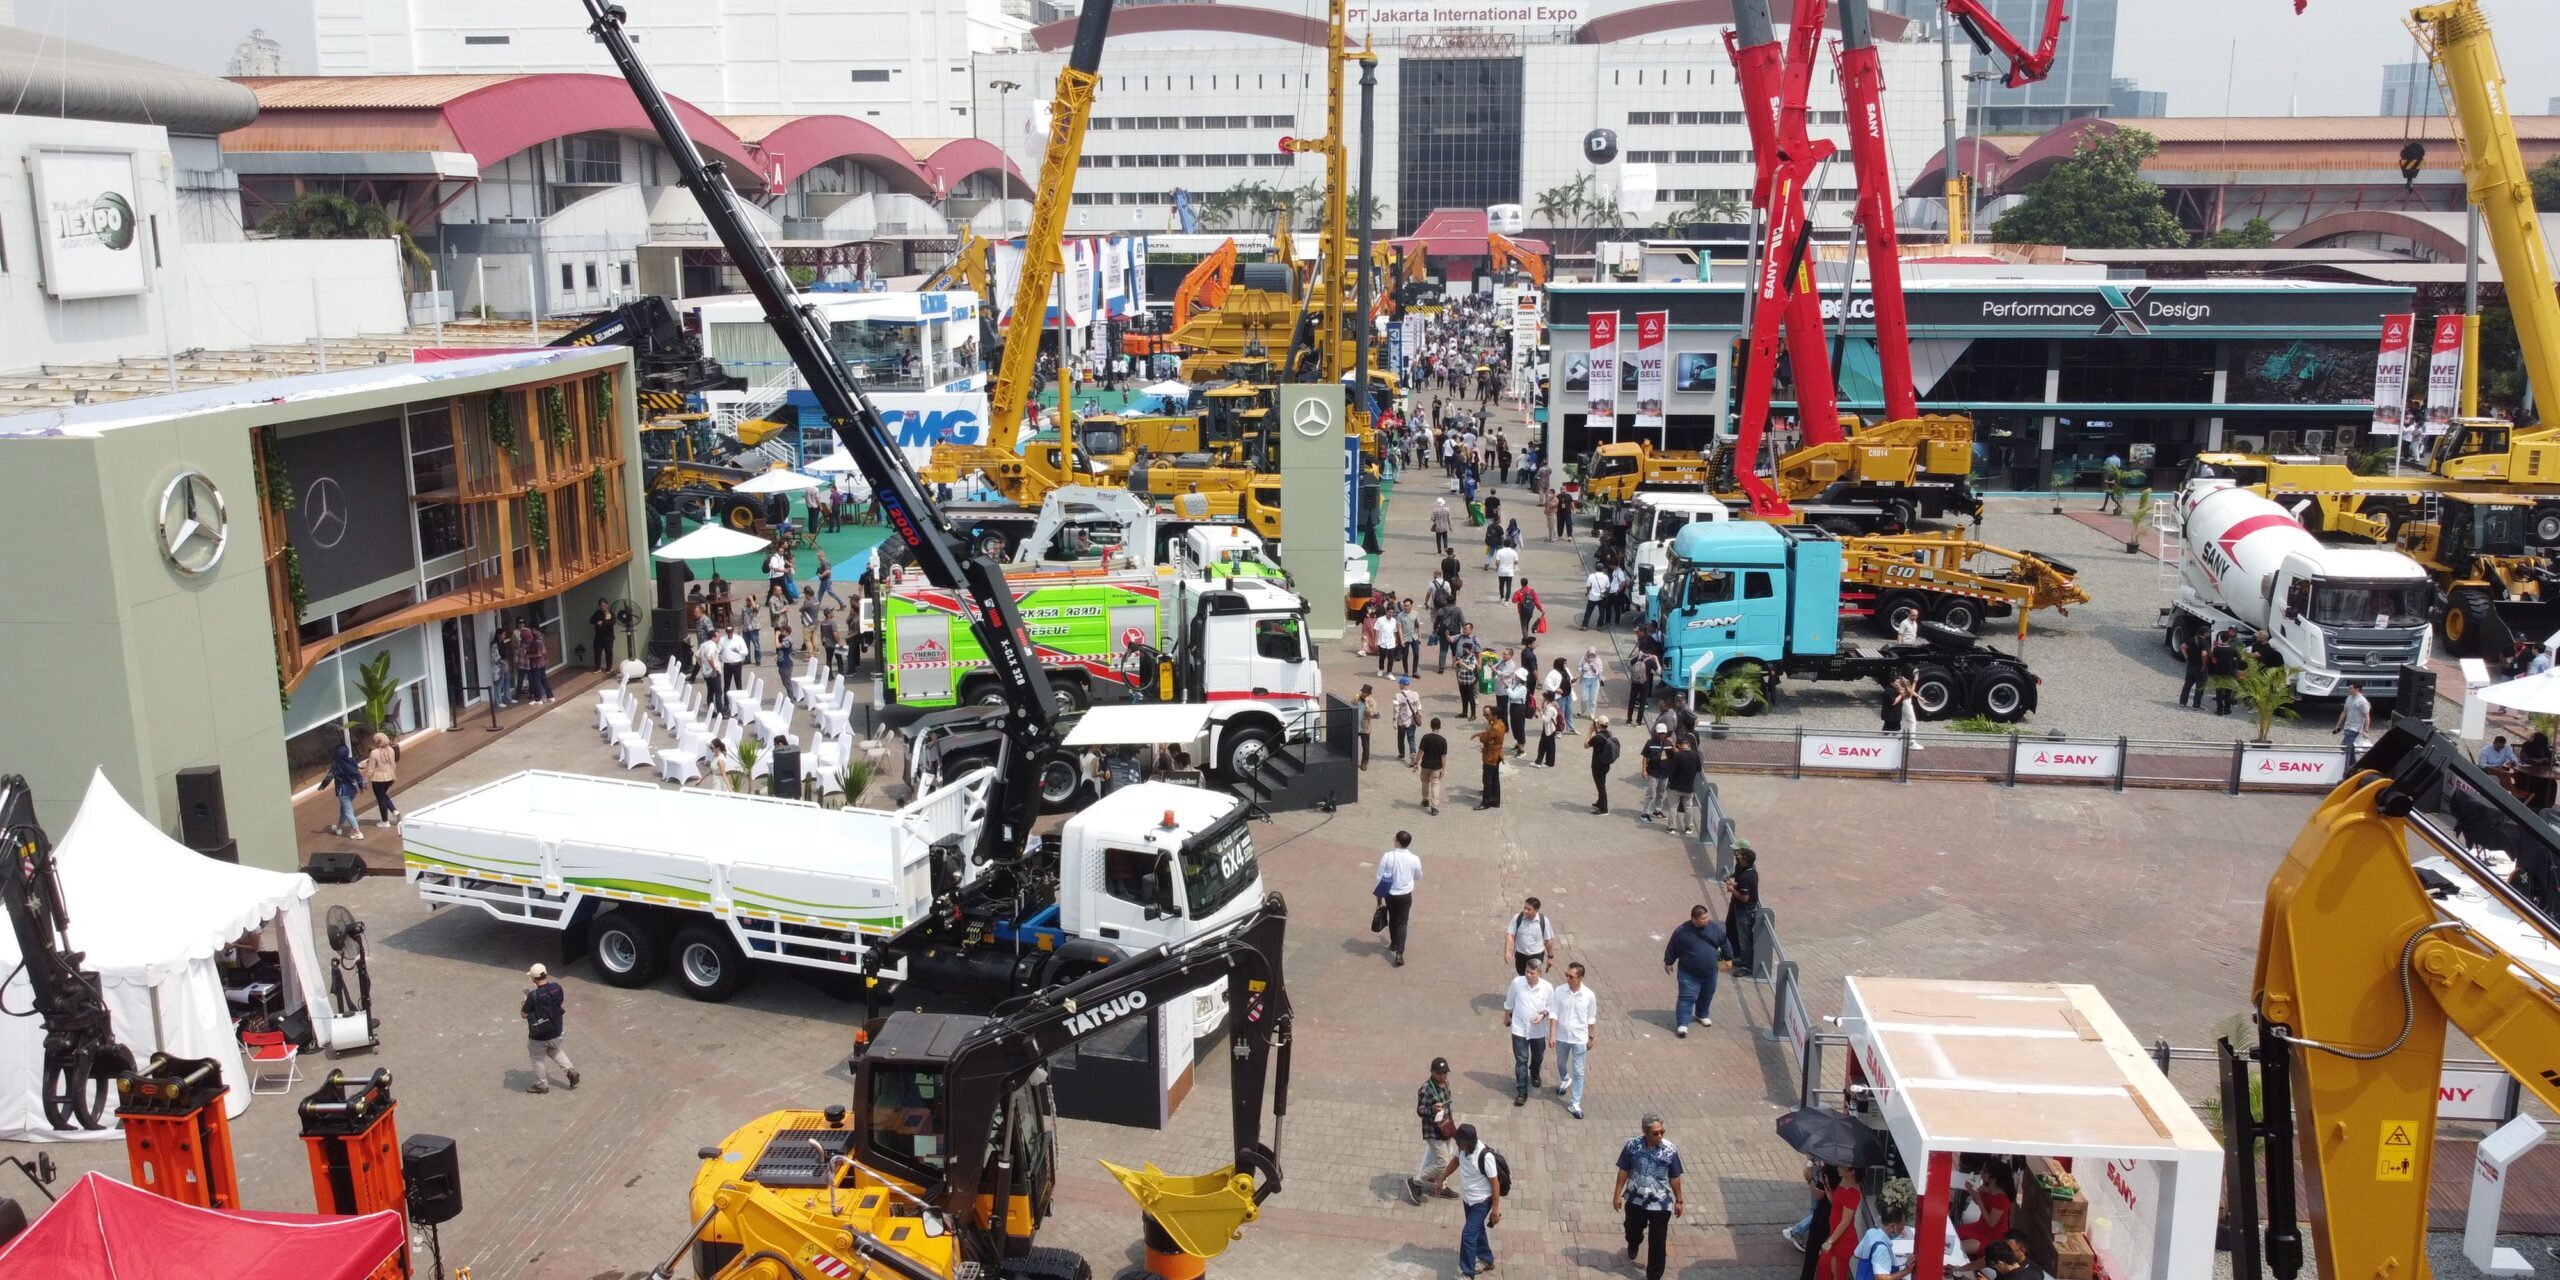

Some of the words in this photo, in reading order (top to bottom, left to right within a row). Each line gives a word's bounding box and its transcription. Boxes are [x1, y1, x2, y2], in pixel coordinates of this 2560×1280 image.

[1348, 9, 1368, 22] PT
[1372, 8, 1429, 22] Jakarta
[1434, 7, 1531, 22] International
[1537, 7, 1578, 23] Expo
[2486, 80, 2503, 115] SANY
[1866, 103, 1880, 138] SANY
[774, 163, 783, 186] A
[1764, 259, 1778, 299] SANY
[1821, 298, 1875, 319] BECO
[1982, 301, 2096, 317] Performance
[2149, 301, 2210, 321] Design
[1591, 359, 1612, 369] WE
[1640, 359, 1661, 369] WE
[2378, 365, 2402, 375] WE
[2432, 365, 2456, 375] WE
[1590, 370, 1612, 378] SELL
[1640, 370, 1661, 378] SELL
[2377, 376, 2400, 384] SELL
[2430, 376, 2453, 384] SELL
[880, 409, 980, 447] CMG
[2202, 541, 2230, 582] SANY
[1886, 564, 1916, 578] C10
[1019, 607, 1059, 618] RKASA
[1686, 614, 1743, 629] SANY
[1001, 639, 1018, 667] X-CLX
[1838, 747, 1882, 757] SANY
[2053, 755, 2098, 765] SANY
[2279, 762, 2324, 772] SANY
[1062, 990, 1147, 1037] TATSUO
[1866, 1044, 1890, 1104] SANY
[2438, 1086, 2475, 1102] NY
[2106, 1161, 2136, 1211] SANY
